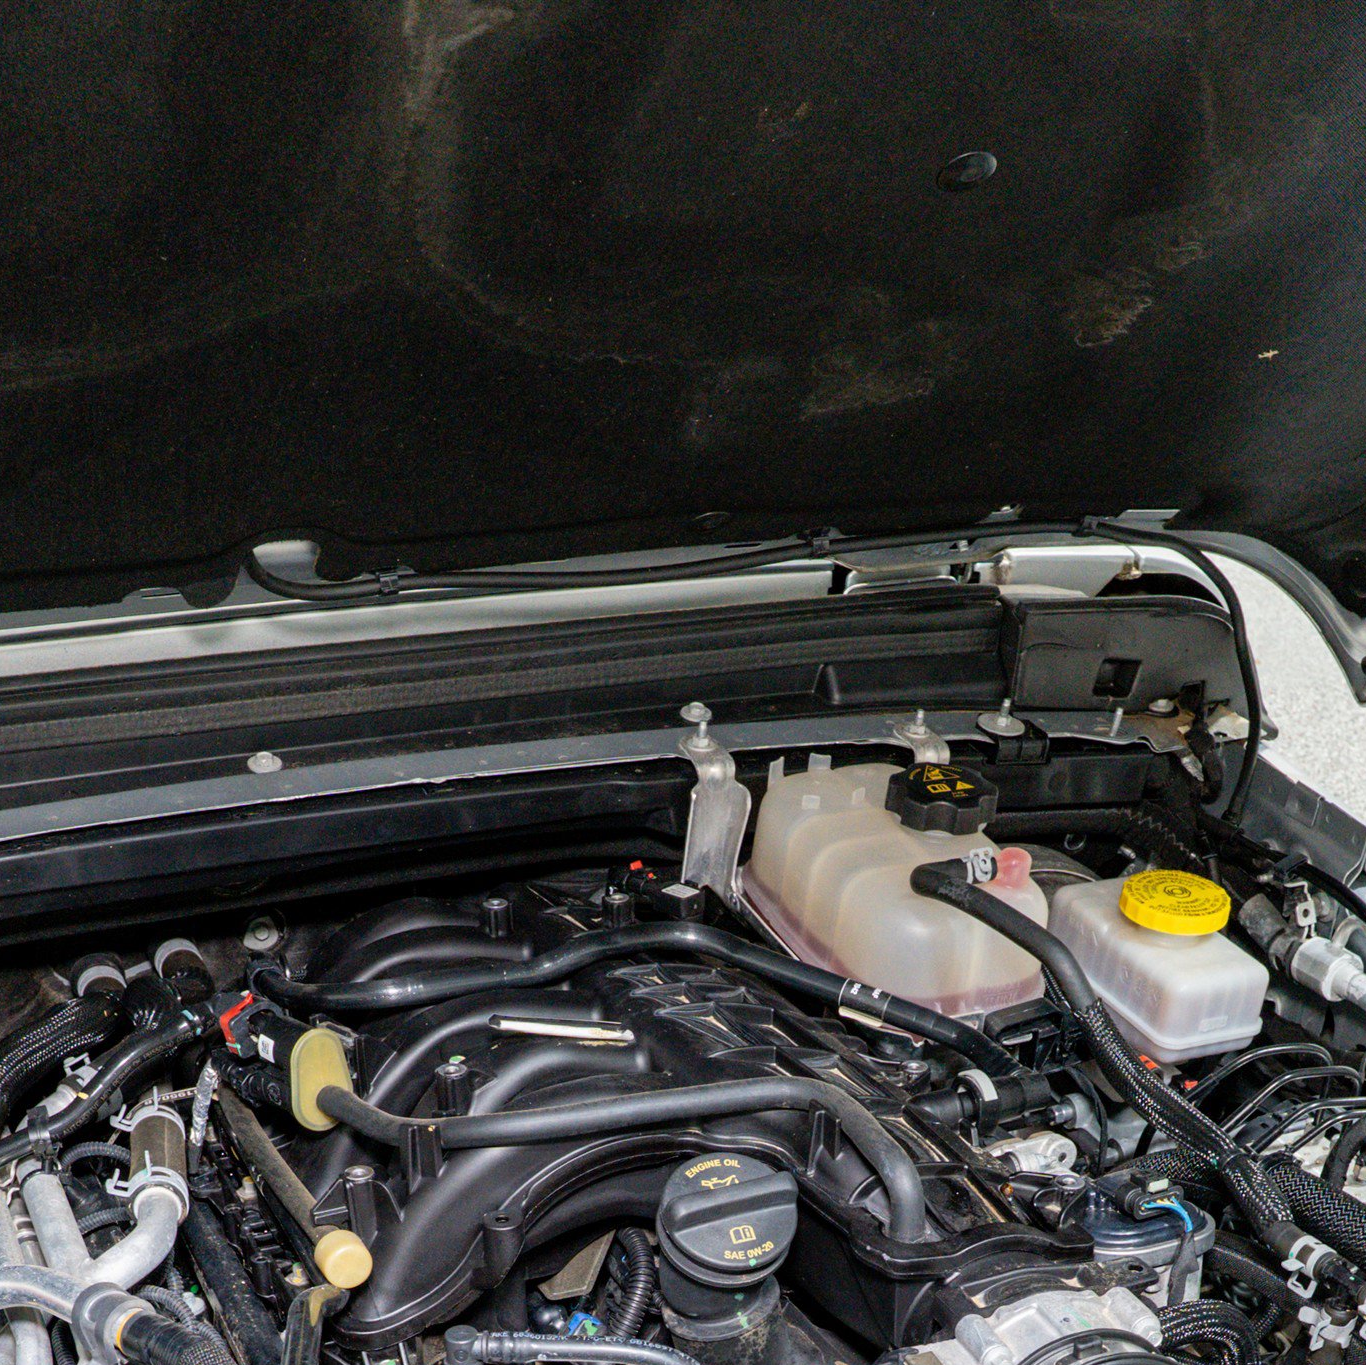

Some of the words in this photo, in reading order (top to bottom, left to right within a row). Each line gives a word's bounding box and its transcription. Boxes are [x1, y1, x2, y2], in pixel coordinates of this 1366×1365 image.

[685, 1158, 722, 1179] ENGINE
[723, 1158, 741, 1168] OIL
[724, 1249, 746, 1261] SAE
[746, 1241, 774, 1259] 0W-20
